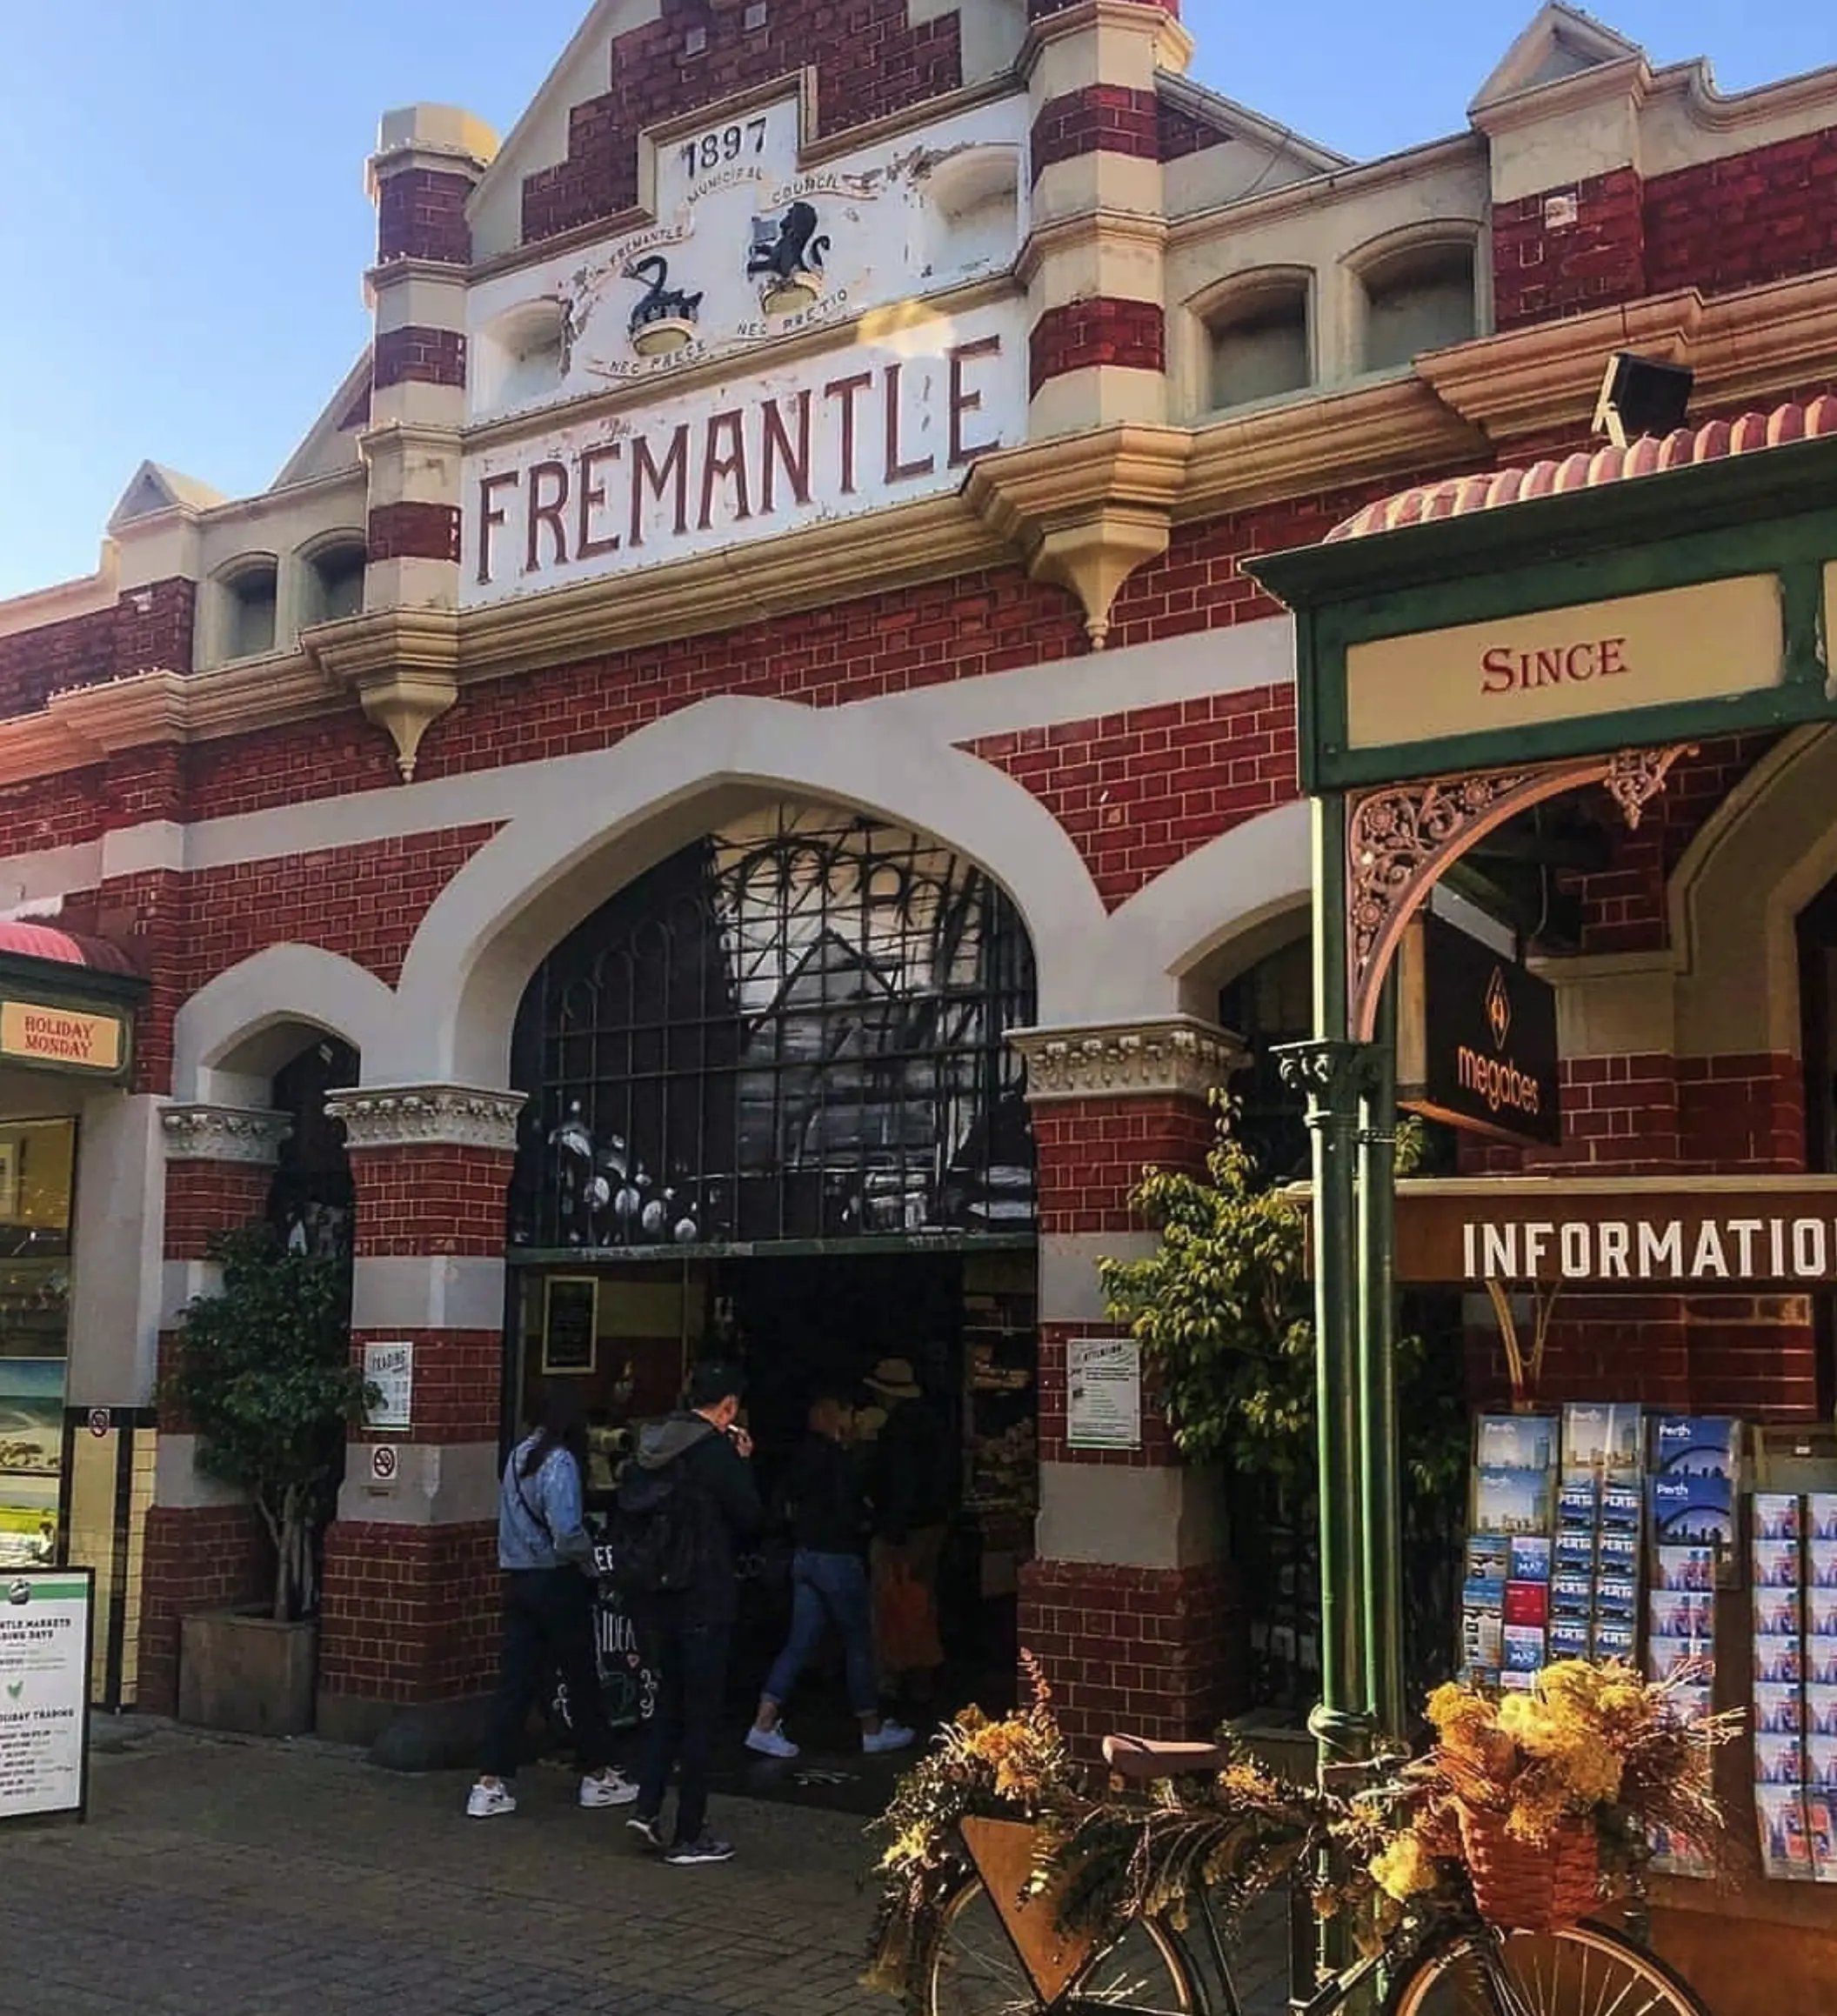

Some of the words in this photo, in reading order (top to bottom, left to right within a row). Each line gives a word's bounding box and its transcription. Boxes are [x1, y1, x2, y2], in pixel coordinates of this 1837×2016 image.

[680, 117, 766, 179] 1897
[686, 165, 763, 204] MUNICIPAL
[772, 174, 839, 204] COUNCIL
[610, 225, 684, 266] FREMANTLE
[738, 323, 767, 336] NEC
[610, 361, 639, 375] NEC
[477, 334, 1001, 586] FREMANTLE
[1480, 637, 1629, 694] SINCE
[24, 1016, 95, 1040] HOLIDAY
[24, 1034, 93, 1058] MONDAY
[1458, 1045, 1539, 1115] megabes
[1463, 1218, 1837, 1278] INFORMATIO
[1659, 1423, 1692, 1437] Perth
[1656, 1482, 1689, 1496] Perth
